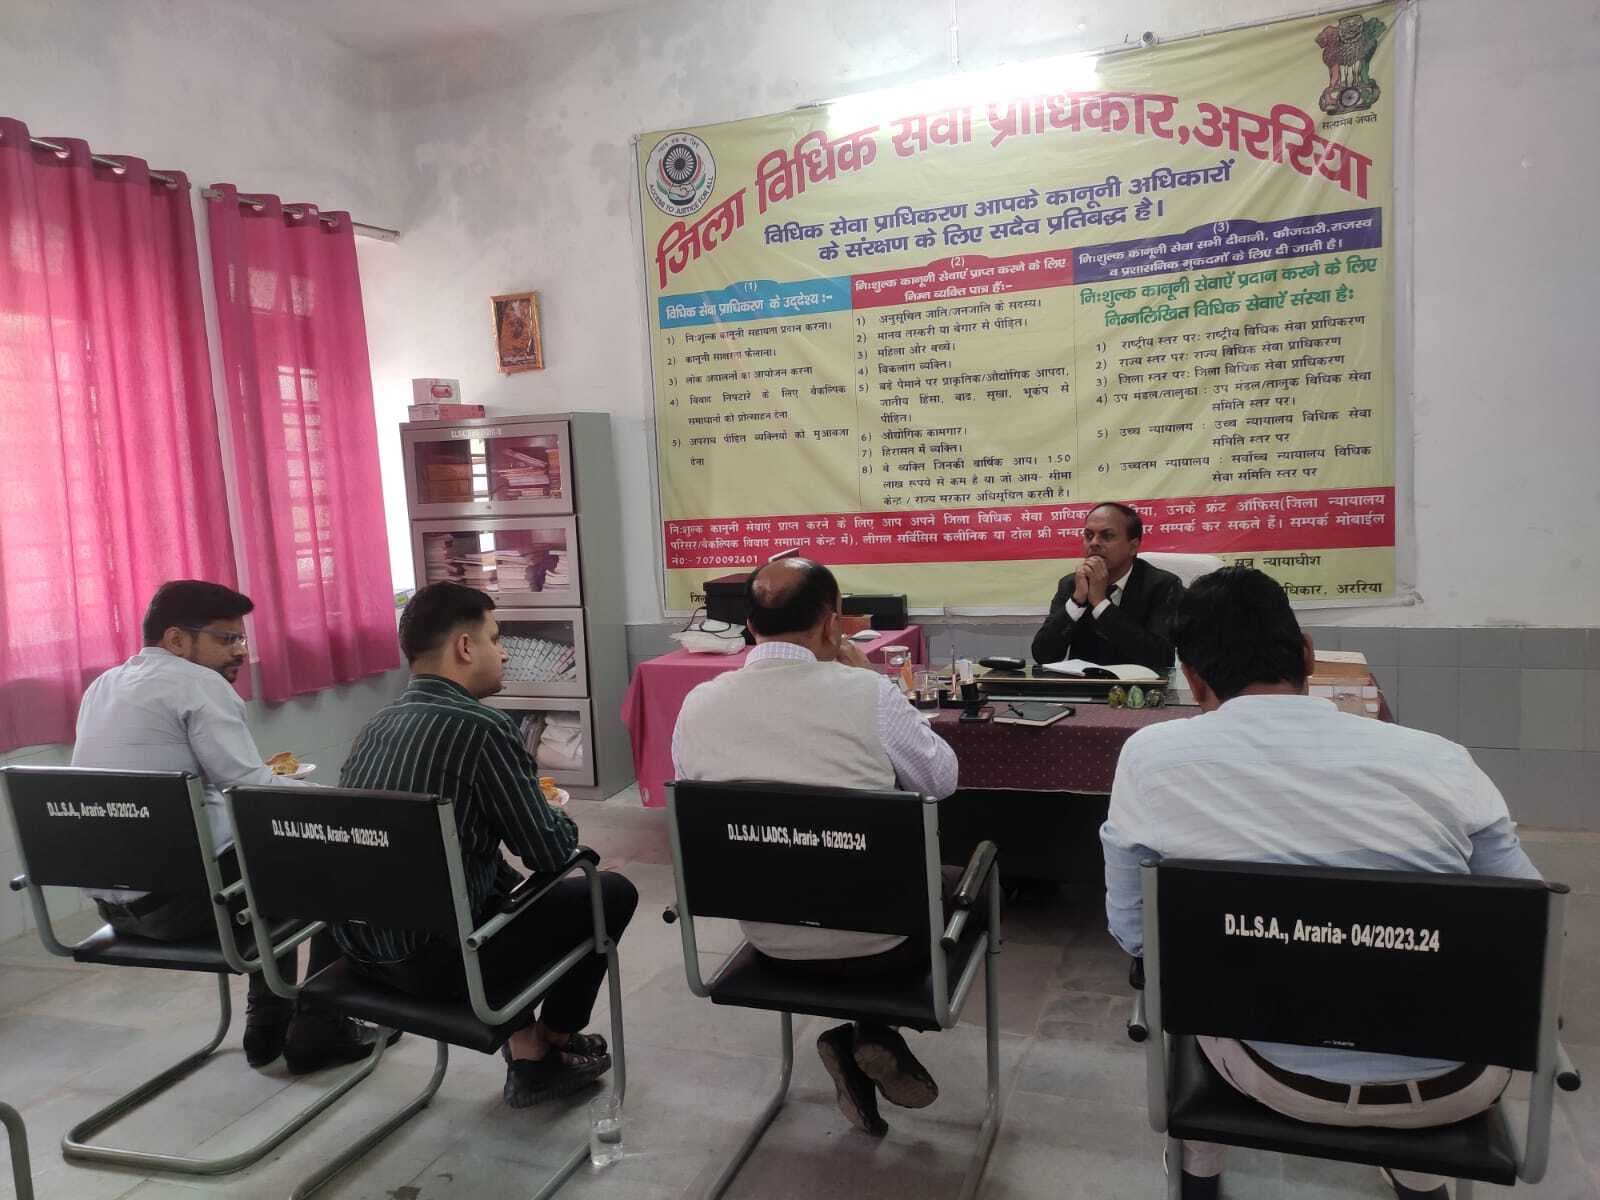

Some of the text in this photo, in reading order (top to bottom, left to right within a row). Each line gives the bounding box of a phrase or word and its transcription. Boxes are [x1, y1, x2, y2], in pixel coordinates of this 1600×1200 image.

[655, 187, 747, 290] जिला
[754, 126, 880, 214] विधिक
[764, 158, 1236, 246] विधिक सेवा प्राधिकरण आपके कानूनी अधिकारों
[819, 240, 839, 262] के
[845, 230, 908, 258] संरक्षण
[915, 227, 937, 250] के
[943, 220, 983, 247] लिए
[990, 215, 1041, 240] सदैव
[1047, 207, 1129, 236] प्रतिबद्ध
[1212, 219, 1230, 235] (3)
[1121, 259, 1179, 278] प्रशासनिक
[1183, 252, 1231, 272] मुकदमों
[1232, 250, 1245, 263] के
[1249, 245, 1273, 262] लिए
[1275, 243, 1289, 257] दी
[1292, 239, 1323, 255] जाती
[1128, 244, 1167, 263] कानूनी
[1170, 240, 1194, 256] सेवा
[1197, 235, 1222, 249] सभी
[900, 271, 936, 290] कानूनी
[938, 267, 968, 282] सेवाएं
[969, 266, 995, 281] प्राप्त
[998, 262, 1025, 276] करने
[1028, 260, 1041, 272] के
[1044, 257, 1067, 271] लिए
[951, 256, 965, 269] (2)
[1141, 276, 1190, 300] कानूनी
[1238, 268, 1278, 289] प्रदान
[1281, 260, 1321, 281] करने
[1325, 258, 1341, 276] के
[1346, 255, 1378, 274] लिए
[933, 285, 966, 299] व्यक्ति
[969, 282, 989, 296] पात्र
[665, 304, 696, 320] विधिक
[699, 302, 717, 317] सेवा
[718, 298, 764, 316] प्राधिकरण
[769, 294, 780, 310] के
[1105, 303, 1189, 328] निम्नलिखित
[1194, 296, 1240, 317] विधिक
[1291, 285, 1331, 305] संस्था
[719, 328, 744, 342] कानूनी
[877, 329, 902, 342] मानव
[1121, 314, 1366, 350] राष्ट्रीय स्तर राष्ट्रीय विधिक सेवा प्राधिकरण
[685, 350, 710, 365] कानूनी
[1119, 334, 1343, 369] राज्य स्तर राज्य विधिक सेवा प्राधिकरण
[1118, 352, 1345, 386] जिला स्तर जिला विधिक सेवा प्राधिकरण
[1305, 368, 1372, 387] विधिक सेवा
[781, 386, 800, 399] लिए
[1211, 395, 1271, 413] समिति स्तर
[1149, 405, 1373, 436] न्यायालय न्यायालय विधिक सेवा
[882, 427, 923, 442] औद्योगिक
[1211, 433, 1271, 449] समिति स्तर
[882, 444, 915, 458] हिरासत
[973, 455, 1004, 469] वार्षिक
[1165, 443, 1372, 470] न्यायालय न्यायालय विधिक
[1212, 466, 1299, 484] सेवा समिति स्तर
[938, 492, 972, 505] सरकार
[710, 493, 1386, 536] कानूनी प्राप्त करने के लिए आप अपने जिला विधिक सेवा उनके न्यायालय
[774, 510, 1386, 548] समाधान टोल सम्पर्क कर सकते सम्पर्क मोबाईल
[695, 554, 760, 566] 7070092401
[1263, 553, 1322, 568] न्यायाधीश
[1336, 580, 1383, 595] अररिया
[761, 825, 792, 848] LADCS,
[821, 829, 867, 851] 16/2023-24
[1224, 913, 1441, 953] D.L.S.A., Araria- 04/2023.24
